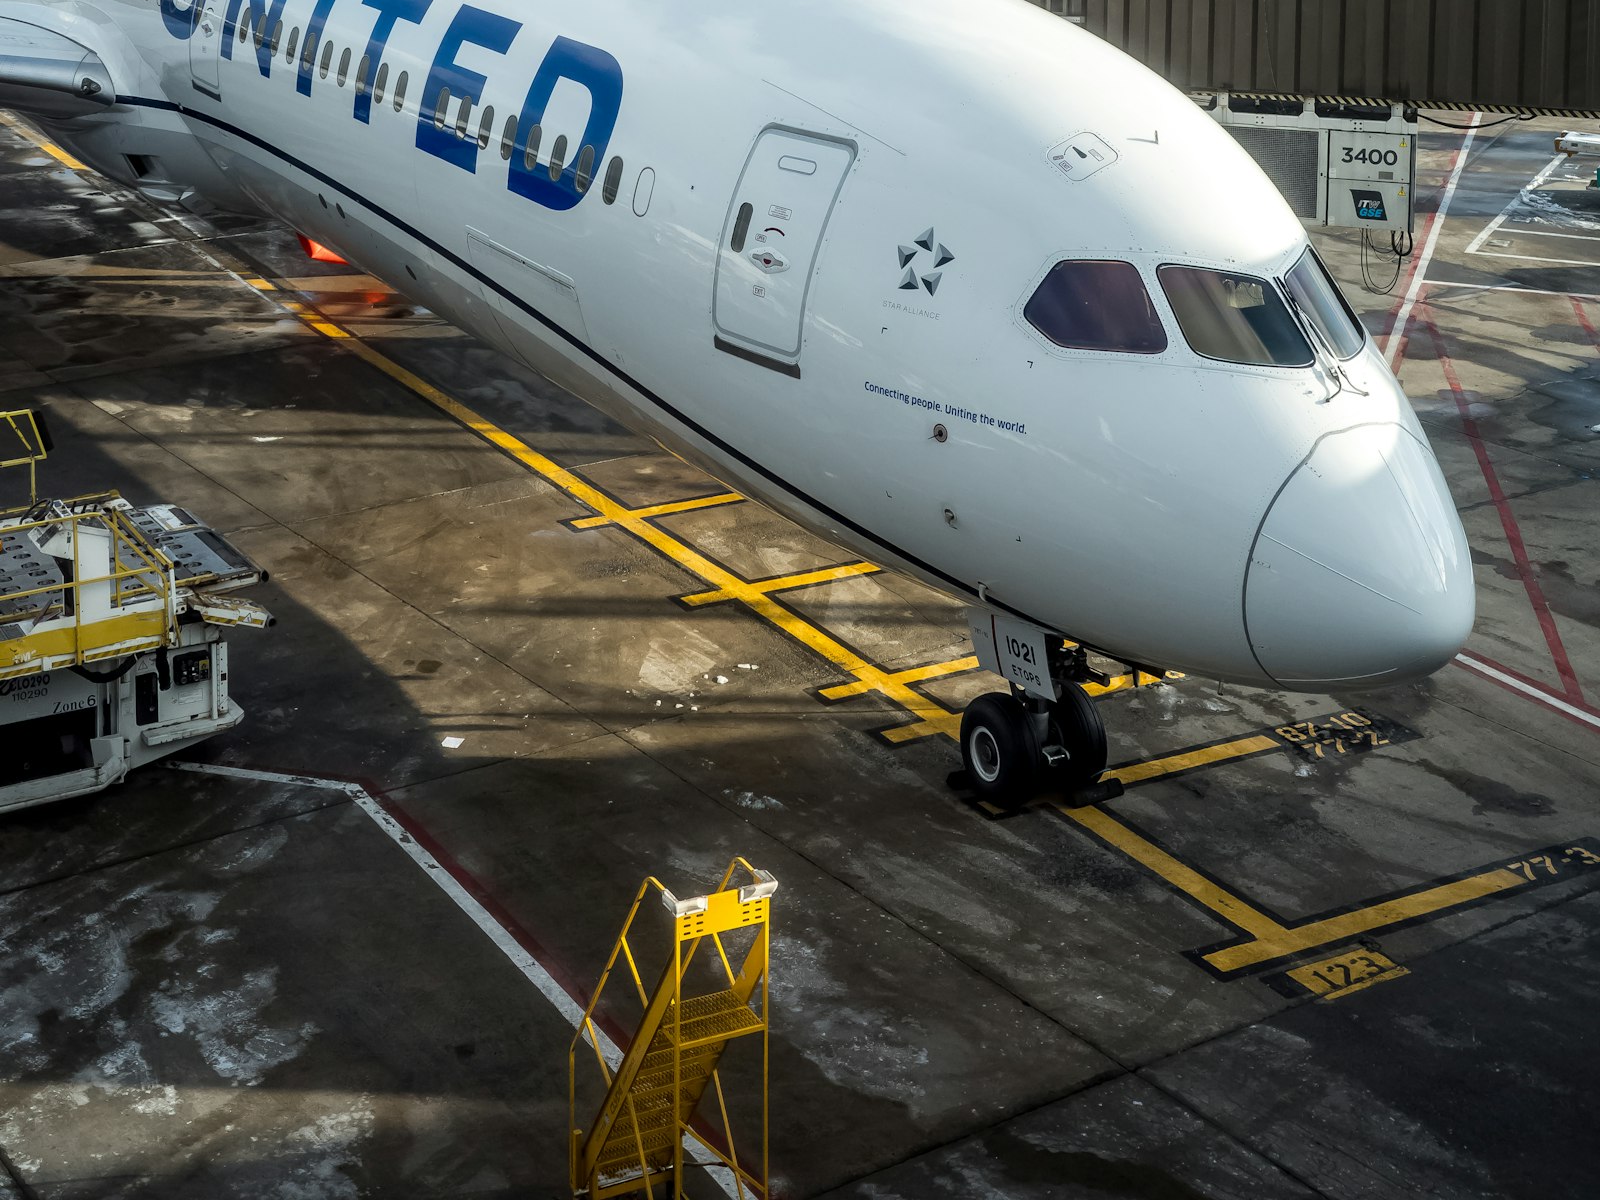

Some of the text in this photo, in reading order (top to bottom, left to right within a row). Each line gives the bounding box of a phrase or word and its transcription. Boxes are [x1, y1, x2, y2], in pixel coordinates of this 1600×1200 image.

[1341, 147, 1398, 166] 3400
[1360, 208, 1382, 218] GSE
[754, 287, 763, 296] EXIT
[882, 300, 941, 321] STAR ALLIANCE
[864, 381, 1027, 435] Connecting people. Uniting the world.
[1006, 635, 1037, 666] 1021
[1012, 664, 1042, 687] ETOPS
[12, 688, 48, 702] 110290
[53, 694, 96, 714] Zone 6
[1311, 956, 1387, 990] 123
